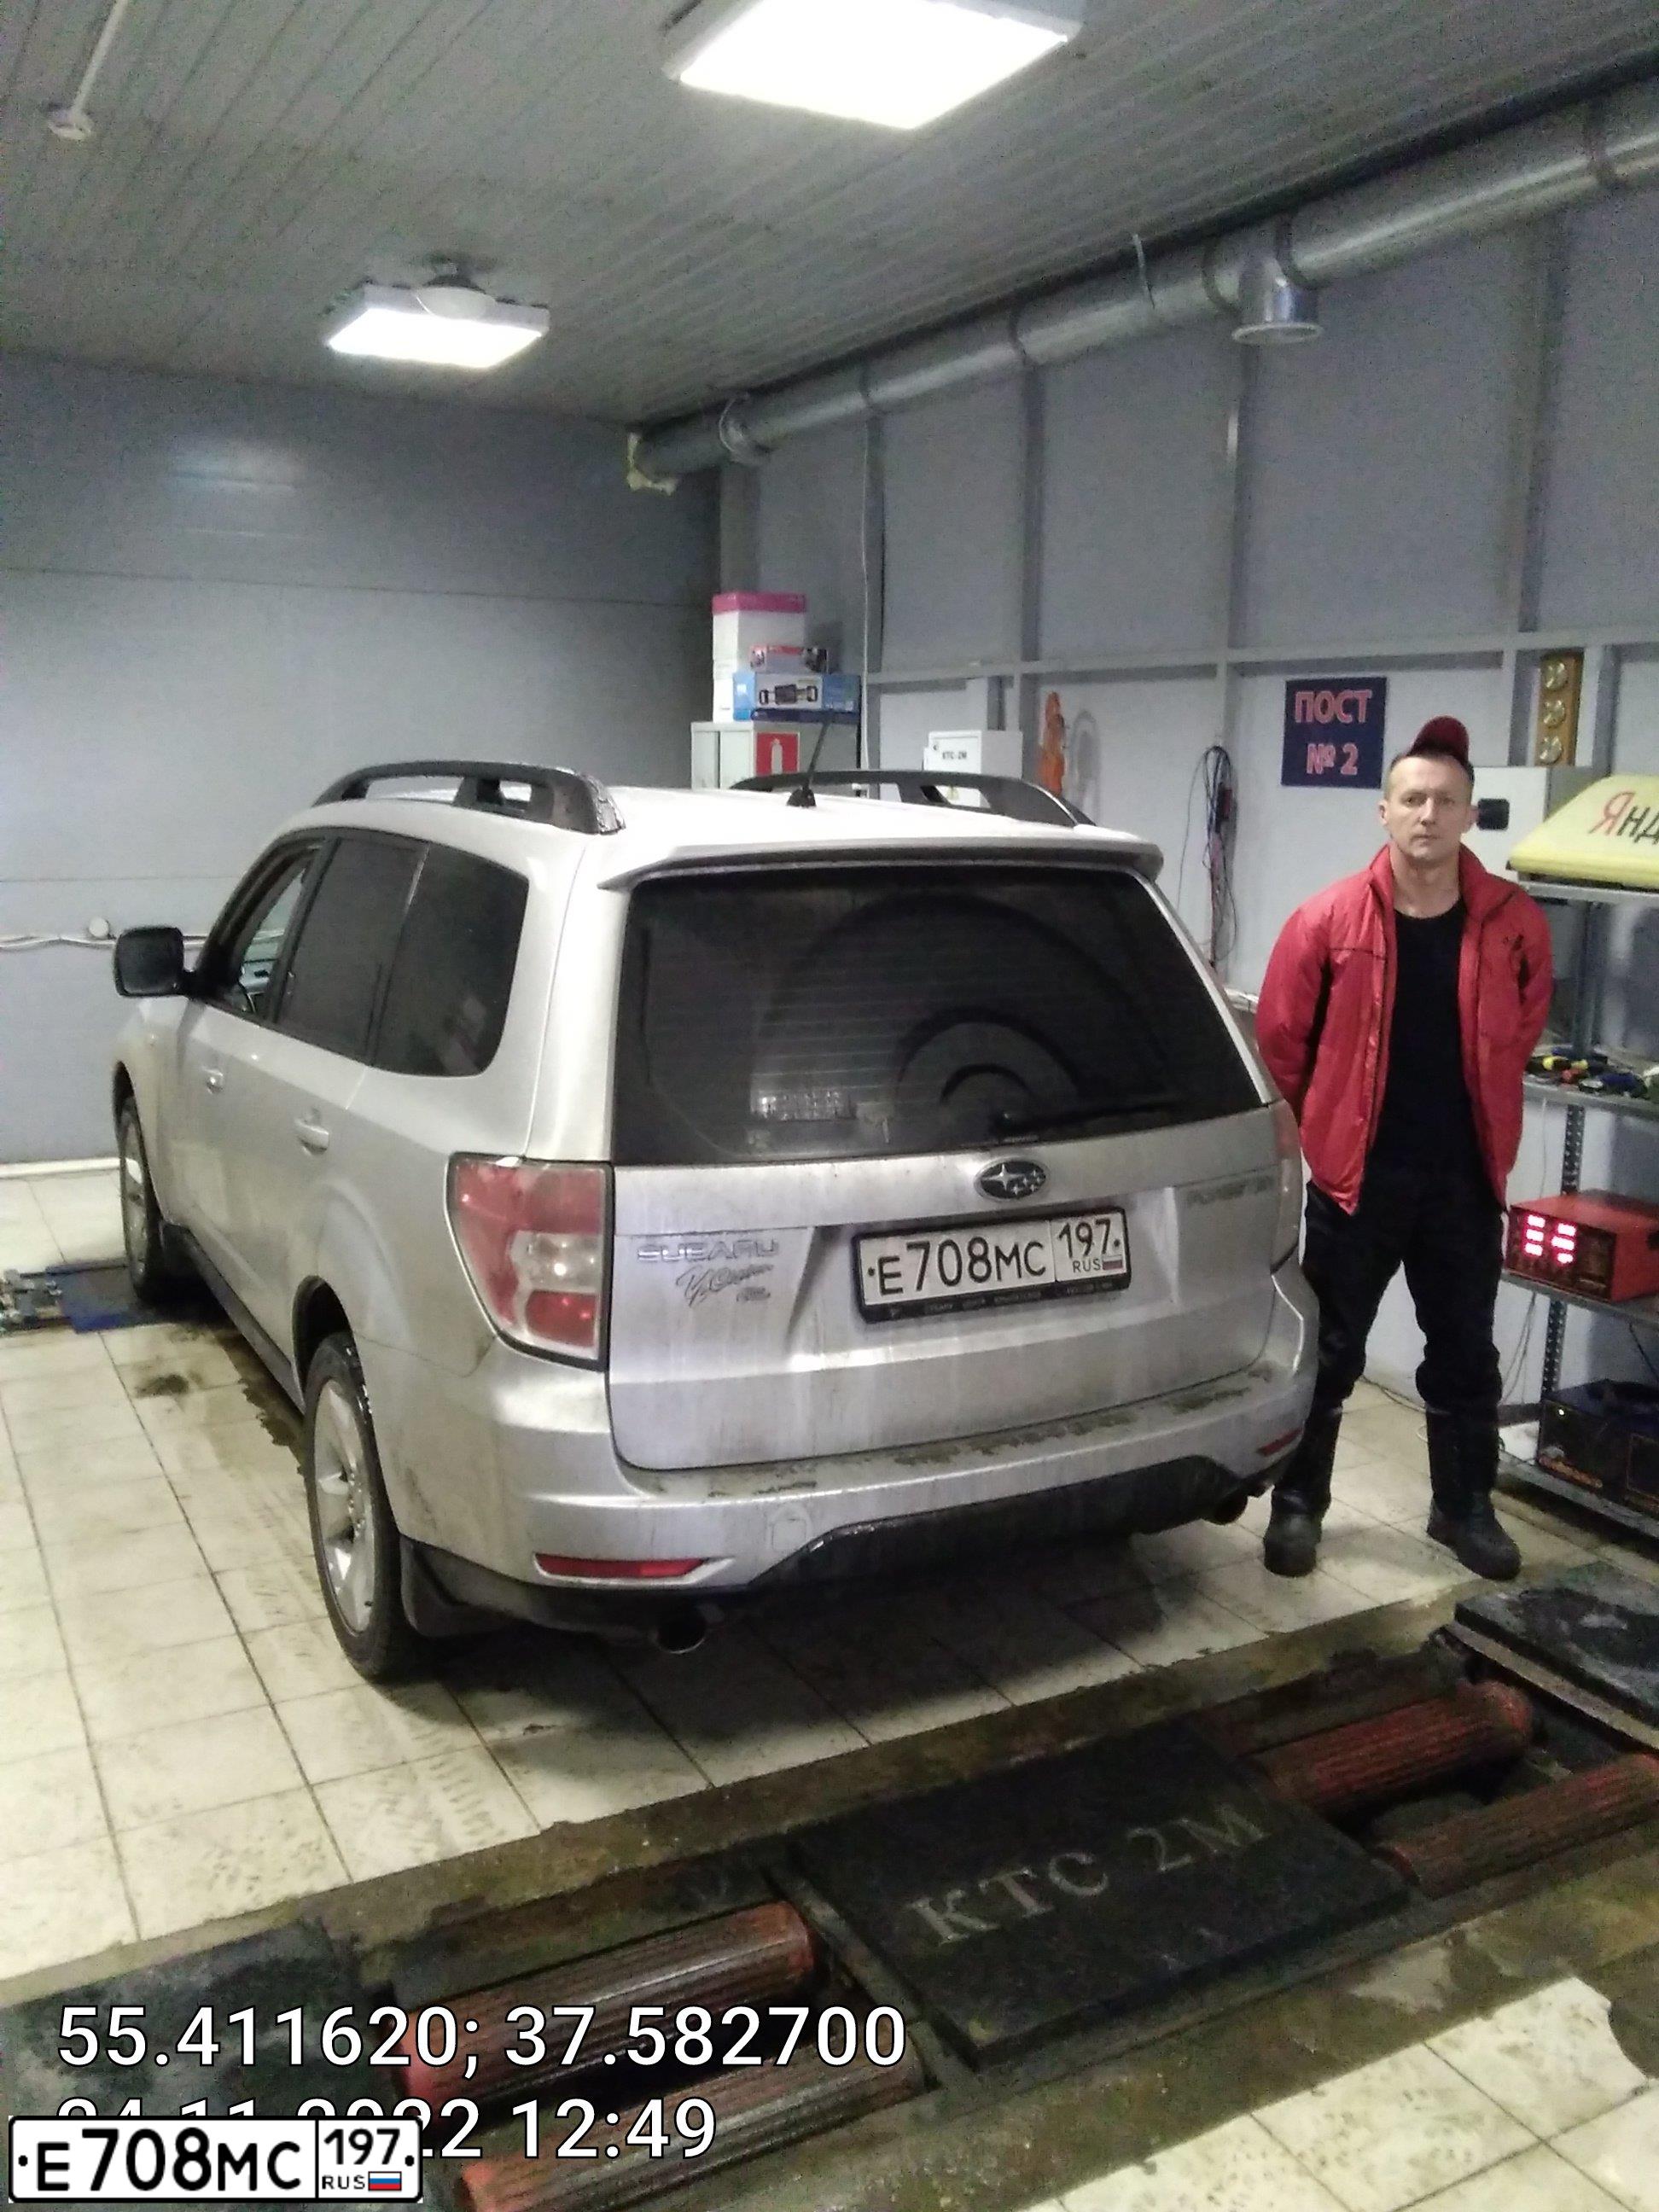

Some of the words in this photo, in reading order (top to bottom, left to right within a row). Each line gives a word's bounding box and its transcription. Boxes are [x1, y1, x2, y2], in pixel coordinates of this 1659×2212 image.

[1295, 689, 1373, 724] ПОСТ
[1306, 742, 1336, 775] №
[1339, 742, 1359, 776] 2
[1058, 1218, 1110, 1259] 197
[1072, 1256, 1101, 1273] RUS
